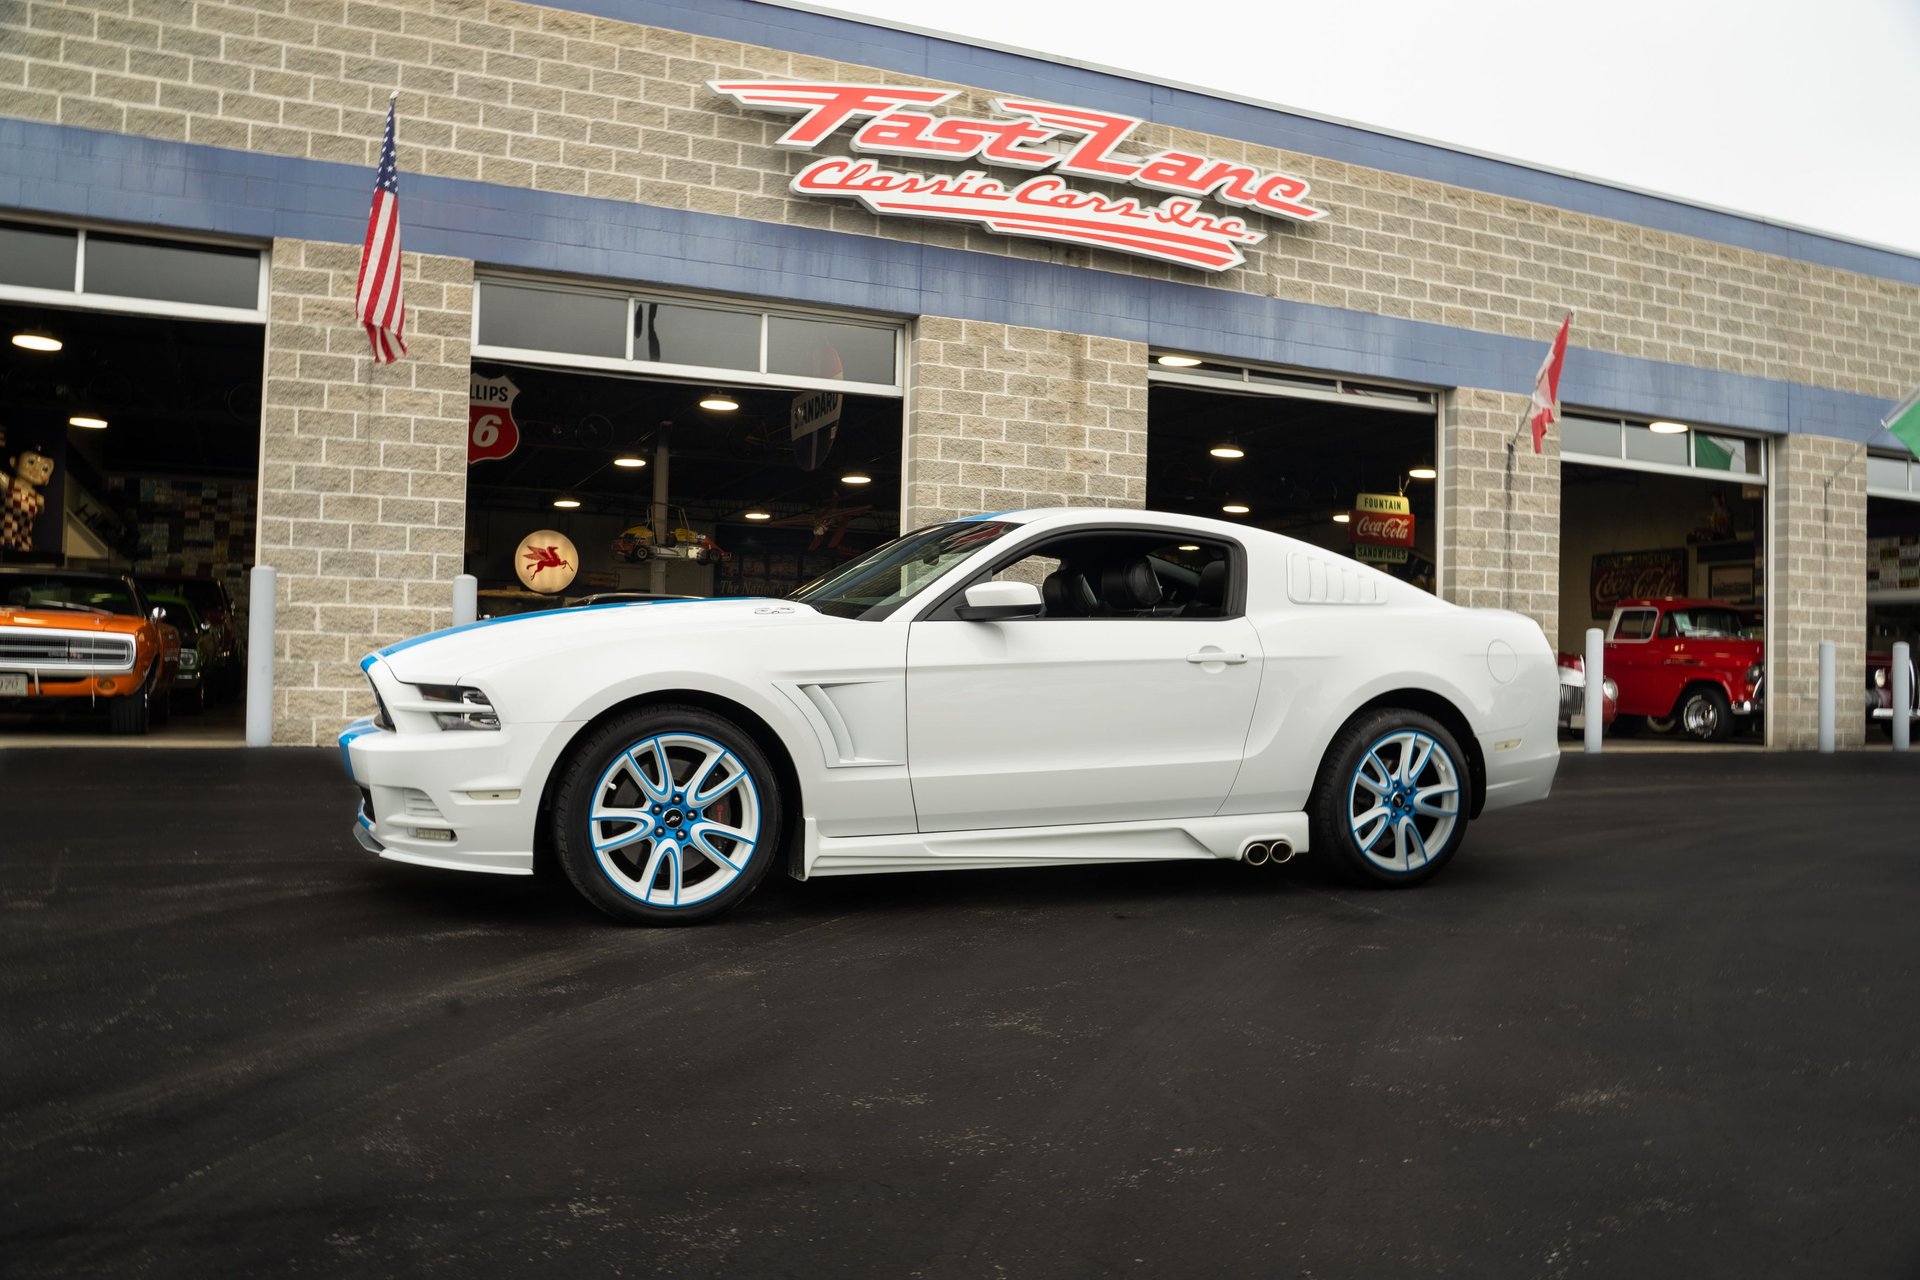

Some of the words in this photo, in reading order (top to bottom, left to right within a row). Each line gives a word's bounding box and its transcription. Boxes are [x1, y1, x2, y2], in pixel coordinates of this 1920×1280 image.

[720, 84, 1053, 164] Fast
[1004, 102, 1318, 217] Lane
[799, 160, 1012, 201] Classic
[1015, 179, 1149, 220] Cars
[1154, 200, 1255, 240] Inc.
[469, 413, 503, 448] 6
[1364, 497, 1402, 511] FOUNTAIN
[1356, 516, 1410, 540] Coca-Cola
[1357, 546, 1406, 560] SANDWICHES
[719, 580, 739, 595] The
